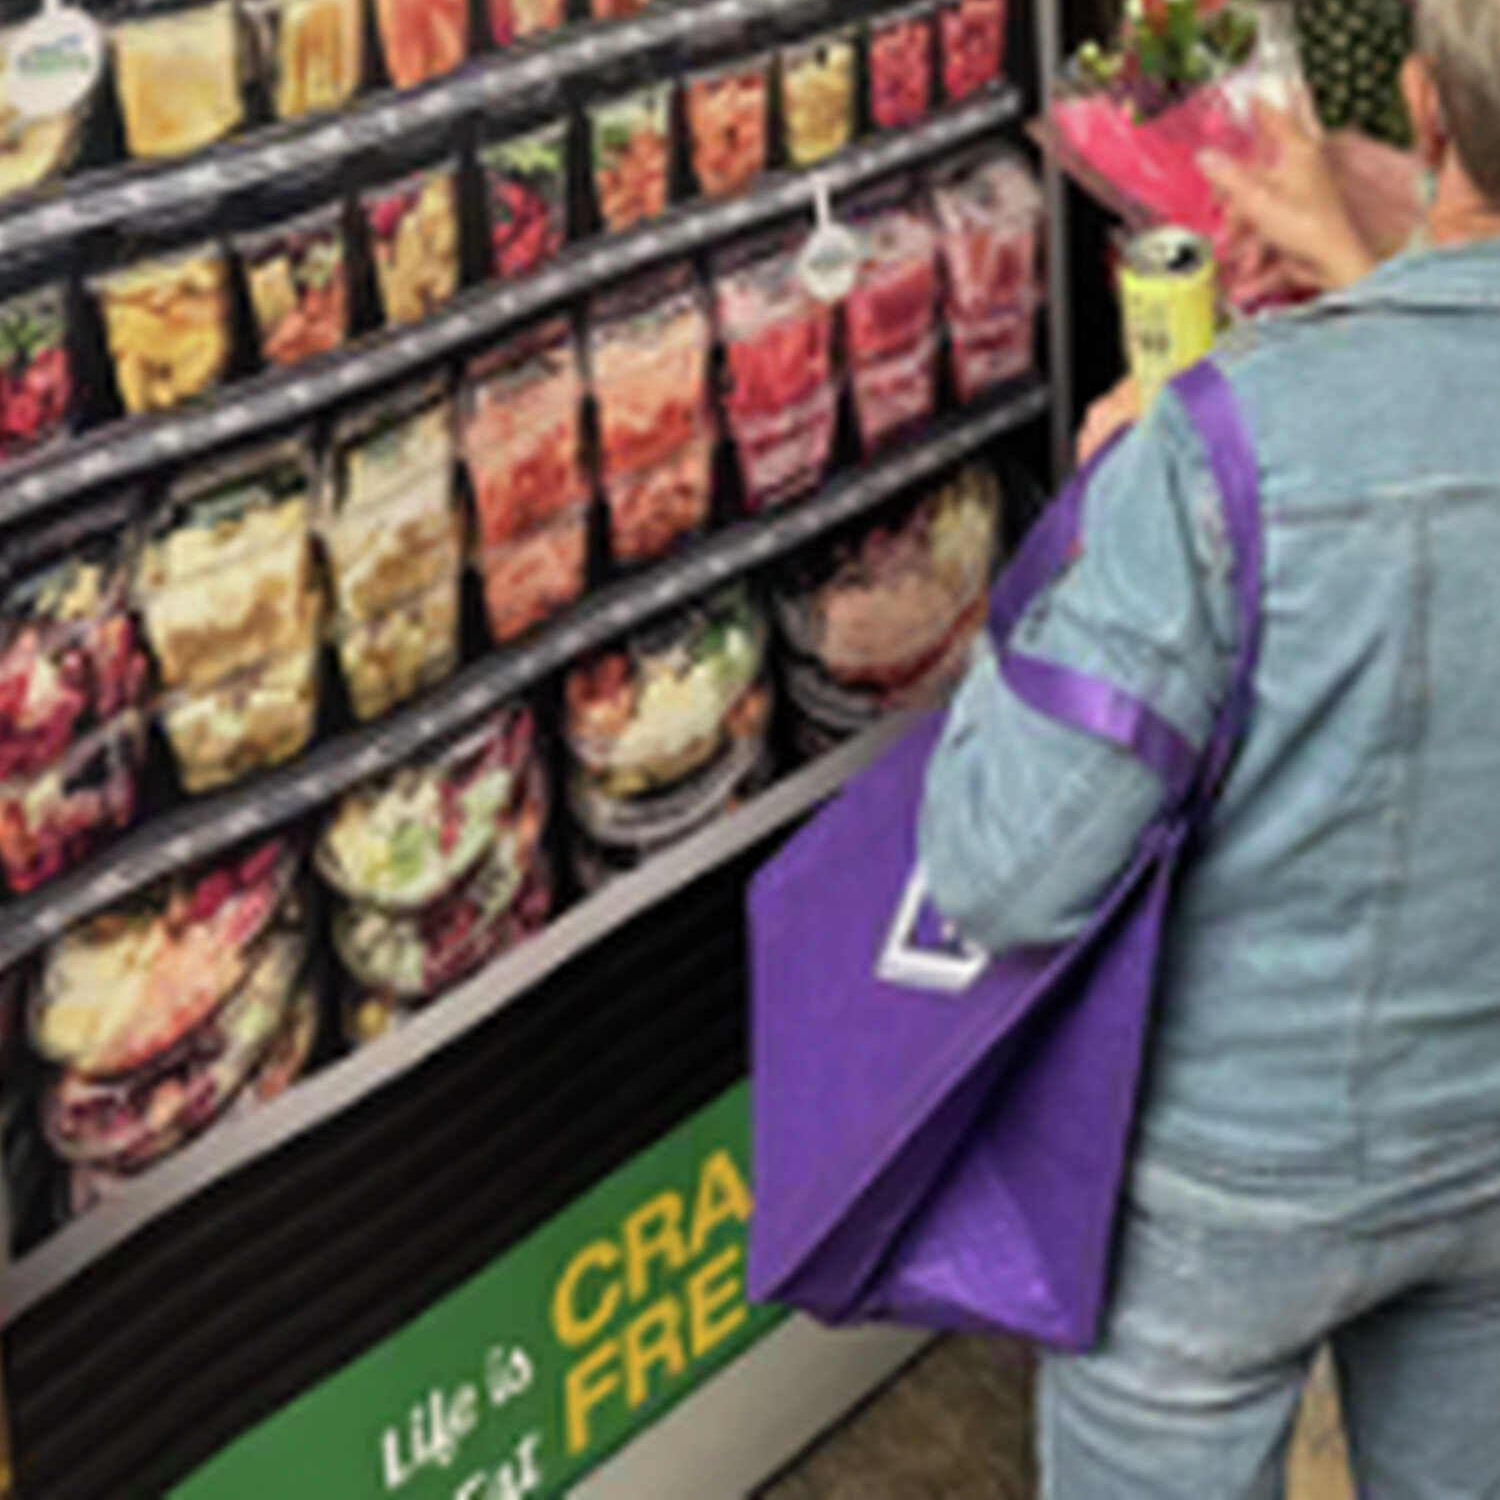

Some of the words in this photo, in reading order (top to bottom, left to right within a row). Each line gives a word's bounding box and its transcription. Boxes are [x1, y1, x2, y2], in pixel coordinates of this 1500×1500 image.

[552, 1147, 755, 1347] CRA
[382, 1384, 478, 1490] Life
[483, 1343, 534, 1406] is
[565, 1244, 749, 1456] FRE
